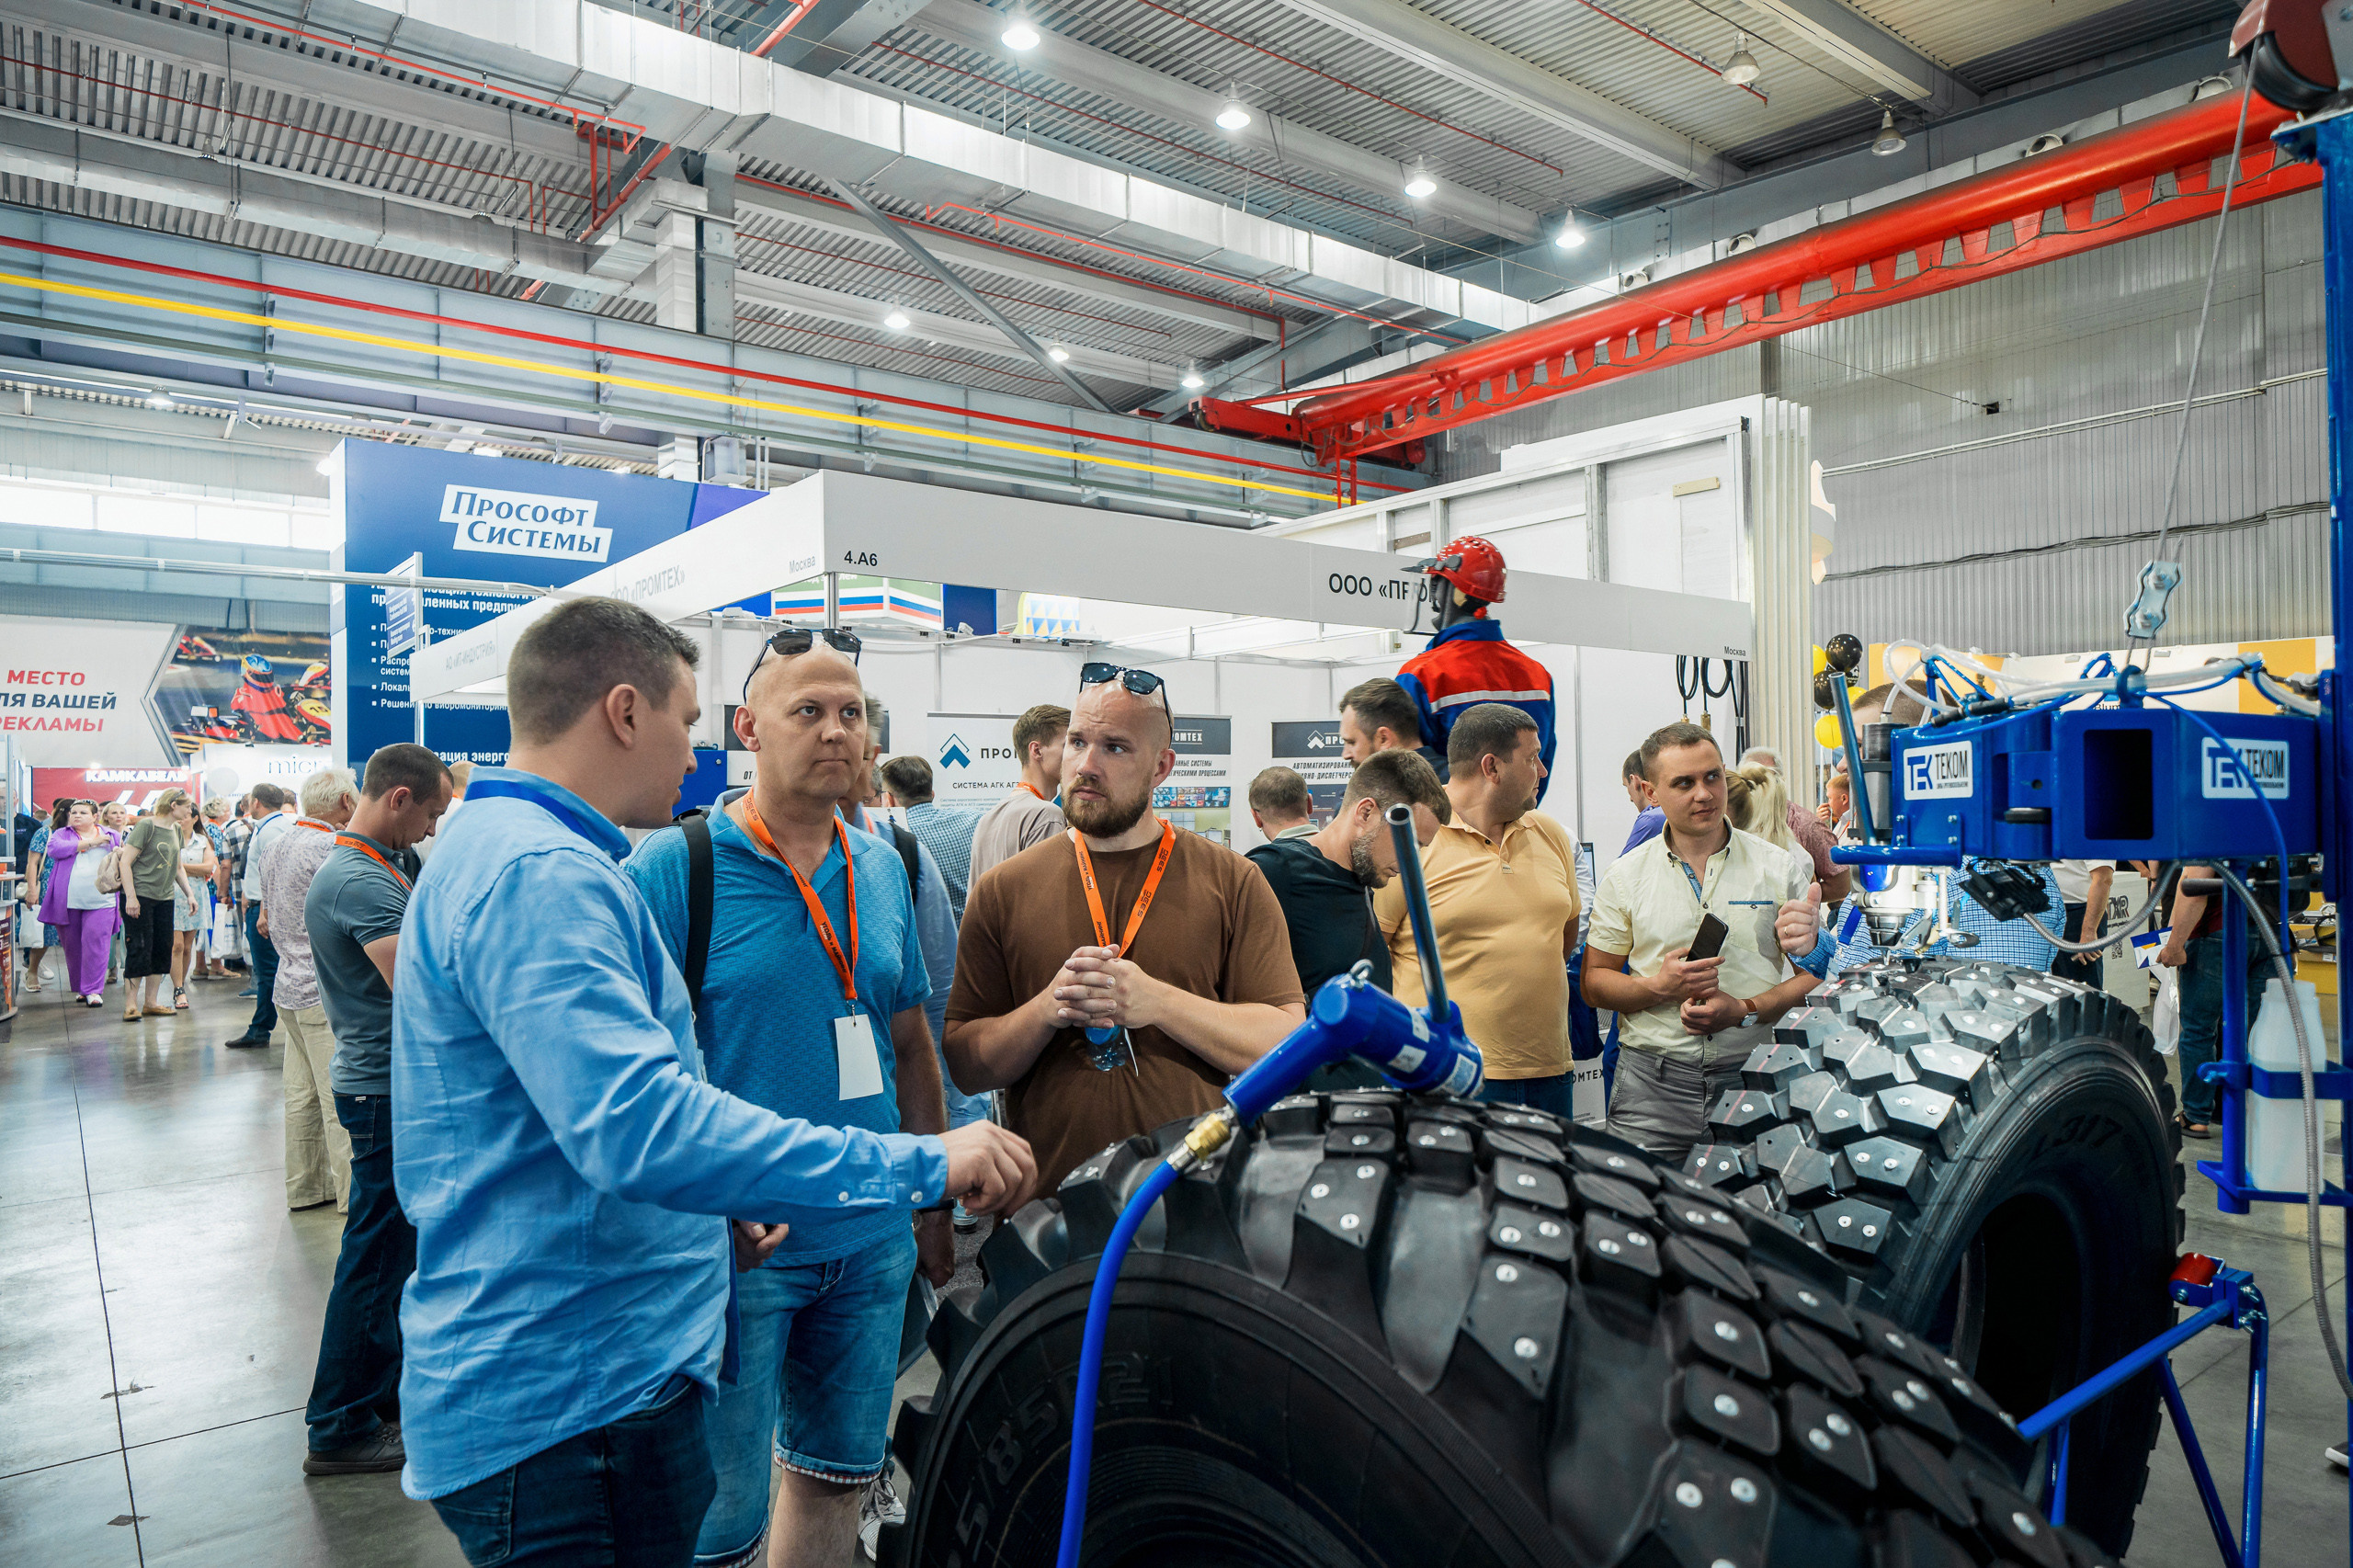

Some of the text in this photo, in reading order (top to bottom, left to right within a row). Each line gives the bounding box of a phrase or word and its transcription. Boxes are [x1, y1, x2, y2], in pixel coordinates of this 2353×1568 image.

[451, 490, 590, 528] Прософт
[467, 520, 601, 554] Системы
[790, 555, 816, 574] Москва
[631, 564, 686, 602] «ПРОМТЕХ»
[1329, 573, 1372, 597] ООО
[1724, 645, 1746, 656] Москва
[6, 669, 85, 686] МЕСТО
[31, 691, 117, 710] ВАШЕЙ
[1173, 733, 1202, 741] ОМТЕХ
[1935, 750, 1968, 780] ТЕКОМ
[2245, 748, 2285, 778] ТЕКОМ
